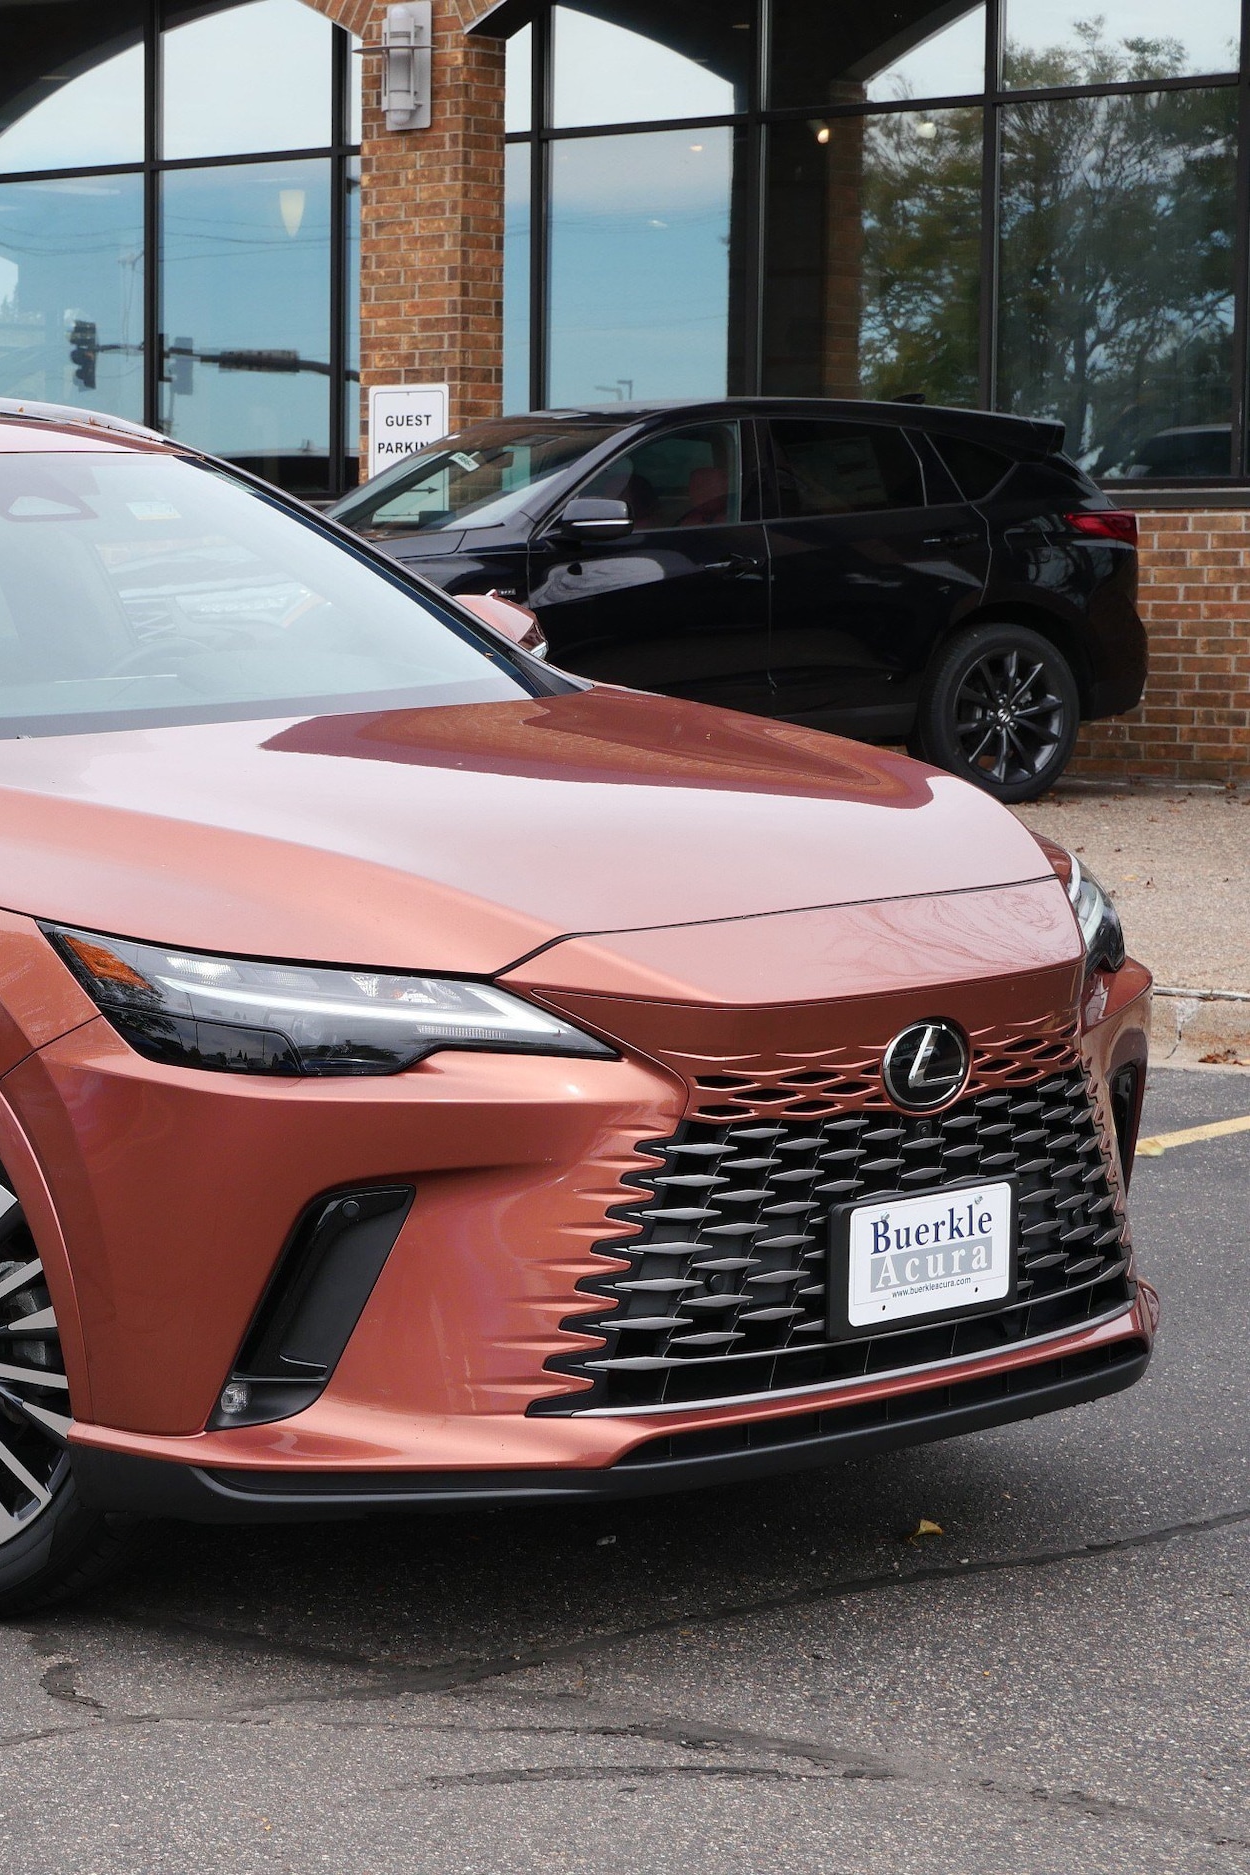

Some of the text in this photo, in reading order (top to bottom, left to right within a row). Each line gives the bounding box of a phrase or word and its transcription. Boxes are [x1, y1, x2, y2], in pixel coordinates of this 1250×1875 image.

[385, 414, 432, 427] GUEST
[378, 441, 429, 454] PARKIN
[870, 1204, 993, 1255] Buerkle
[875, 1245, 988, 1290] Acura
[891, 1276, 972, 1298] www.buerkleacura.com
